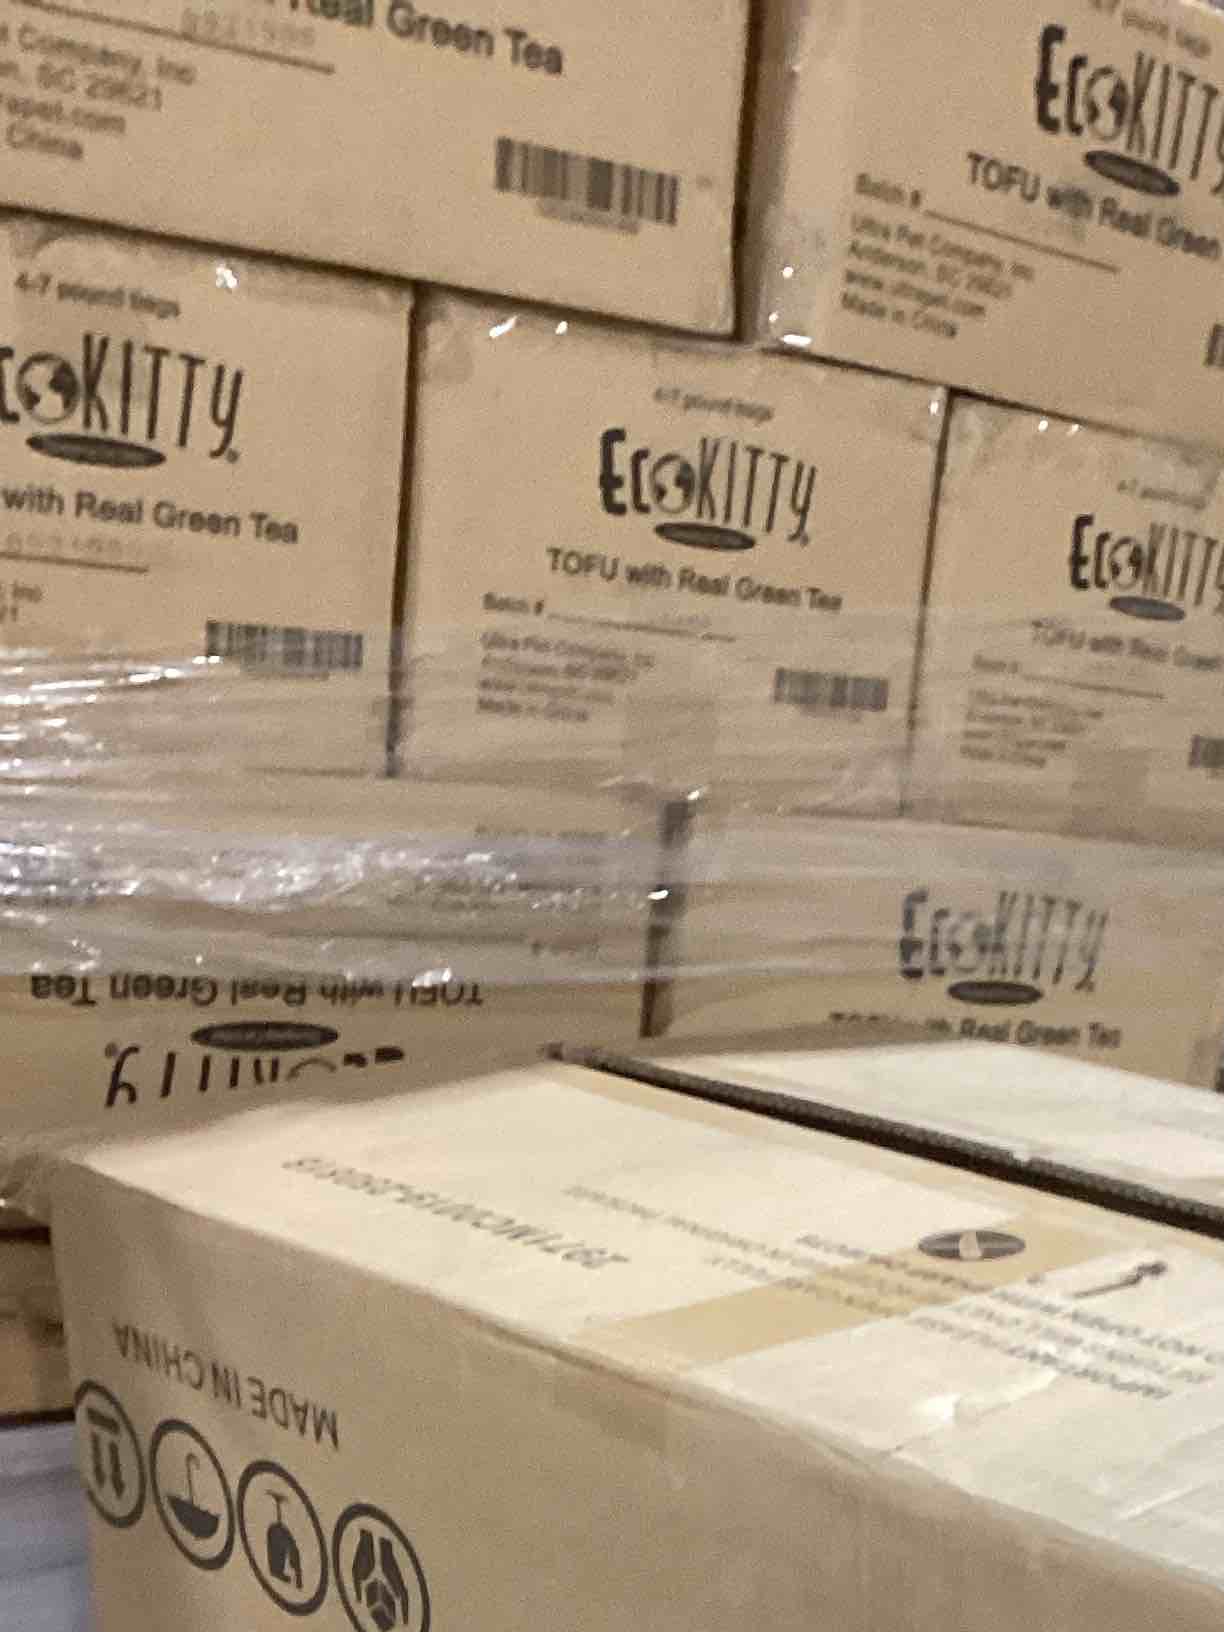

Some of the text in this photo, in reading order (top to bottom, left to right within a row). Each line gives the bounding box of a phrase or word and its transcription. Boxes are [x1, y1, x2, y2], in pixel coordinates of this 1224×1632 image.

[386, 0, 494, 57] Green
[503, 28, 563, 75] Tea
[967, 151, 1041, 203] TOFU
[0, 484, 299, 545] with Real Green Tea
[546, 546, 620, 582] TOFU
[29, 973, 97, 1007] Tea
[109, 974, 219, 1008] Green
[111, 1321, 340, 1451] MADE IN CHINA
